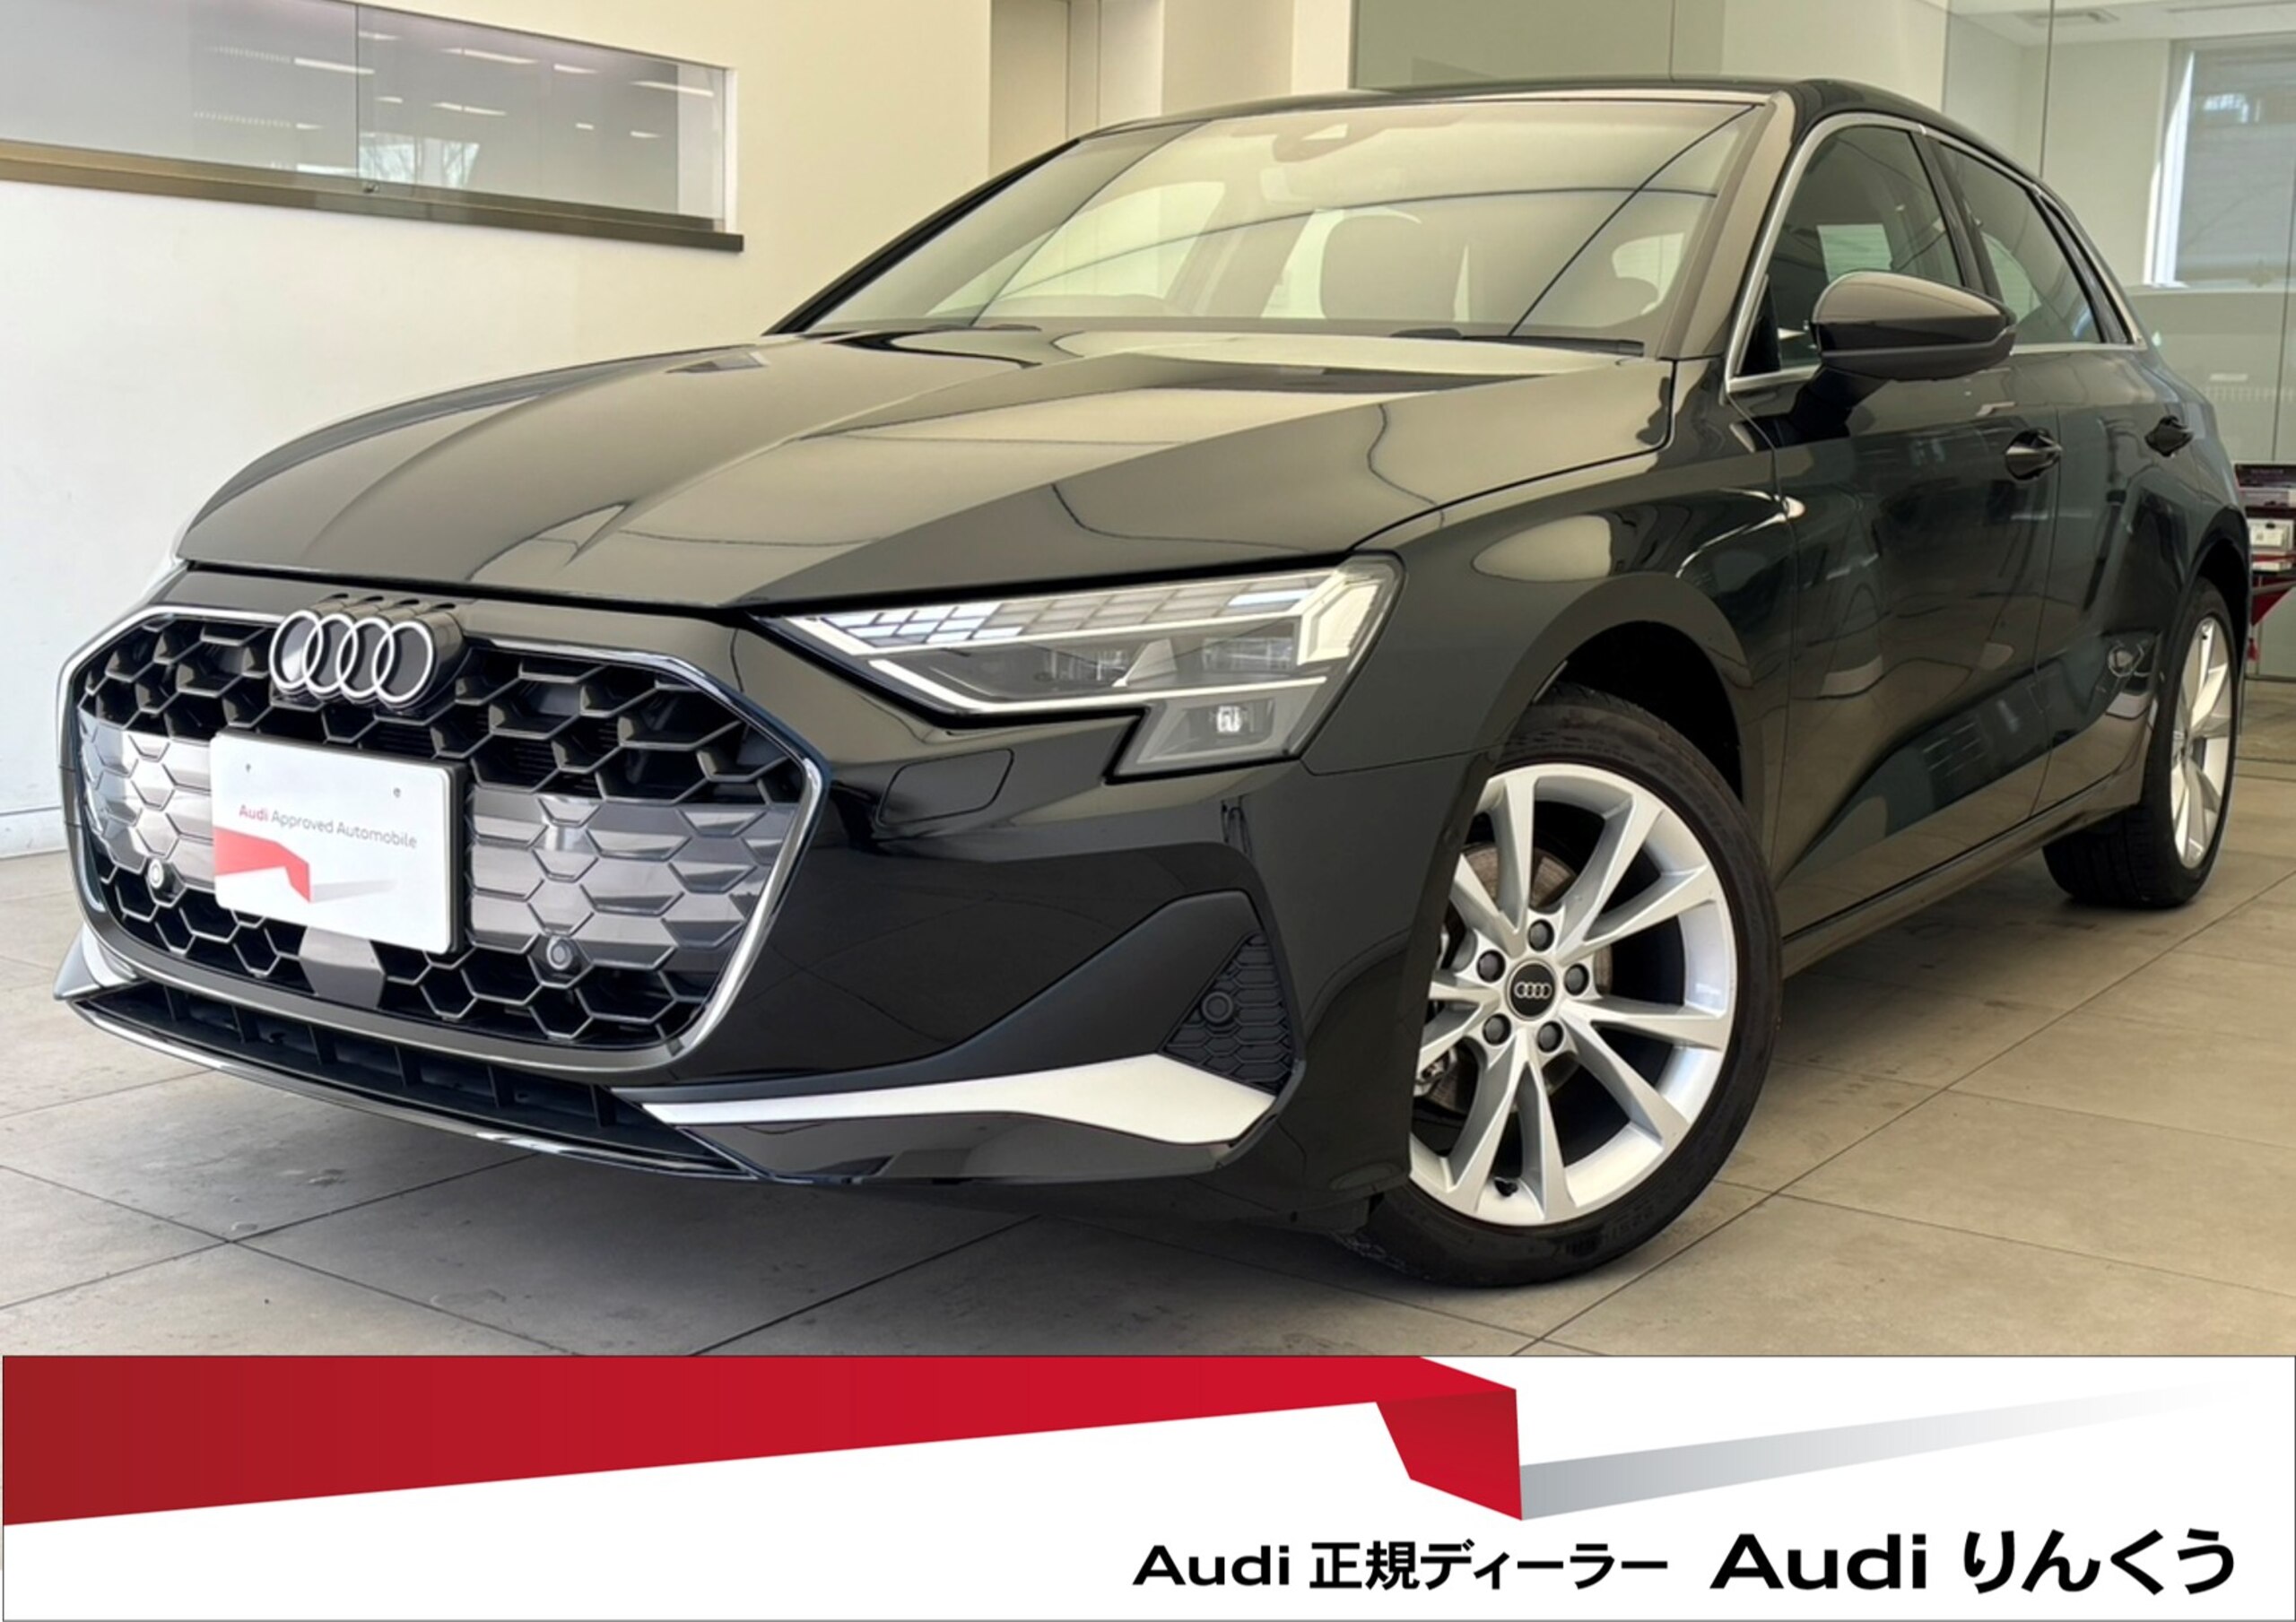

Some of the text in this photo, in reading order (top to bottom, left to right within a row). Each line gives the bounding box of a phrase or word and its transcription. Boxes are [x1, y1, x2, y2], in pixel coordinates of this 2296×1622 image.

[239, 804, 418, 848] Audi Approved Automobile
